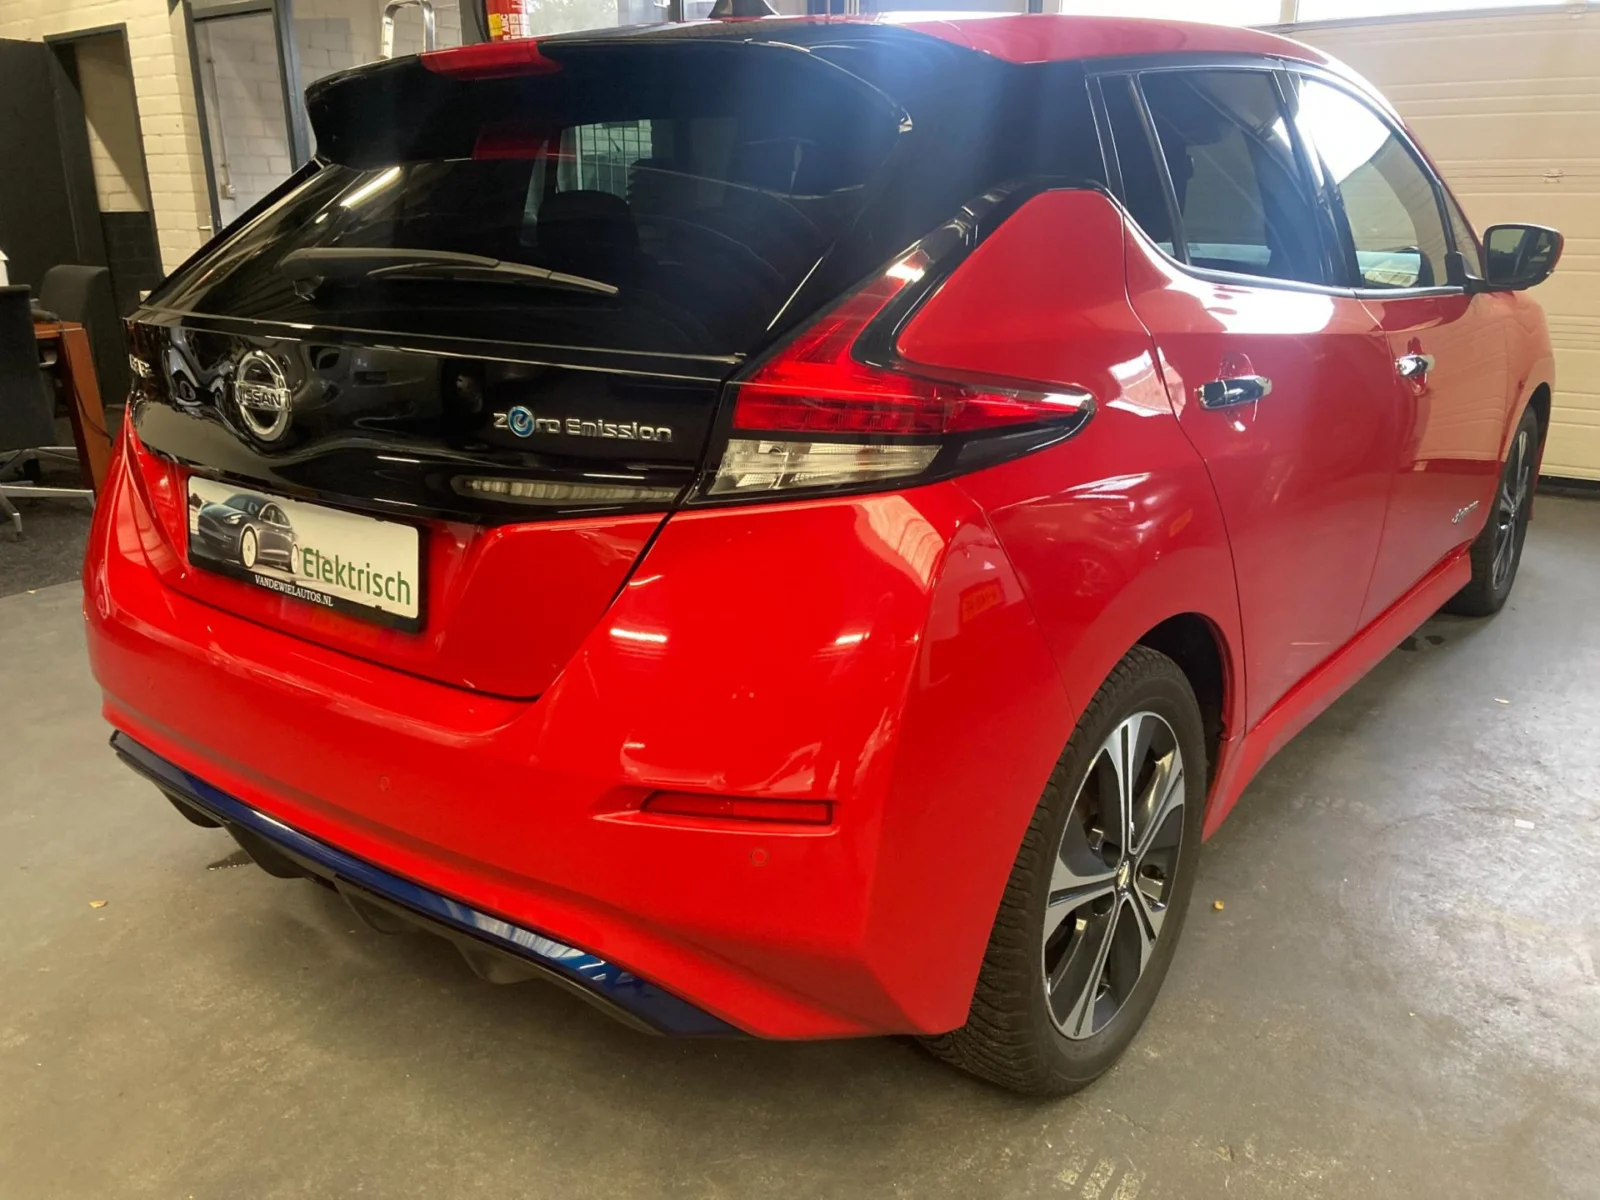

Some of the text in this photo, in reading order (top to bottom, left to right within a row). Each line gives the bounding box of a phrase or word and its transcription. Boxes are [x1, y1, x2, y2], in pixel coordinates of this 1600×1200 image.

[238, 386, 282, 408] NISSAN
[565, 417, 673, 442] Emission
[254, 574, 334, 607] VANDEWIELAUTOS.NL
[302, 547, 411, 606] Elektrisch
